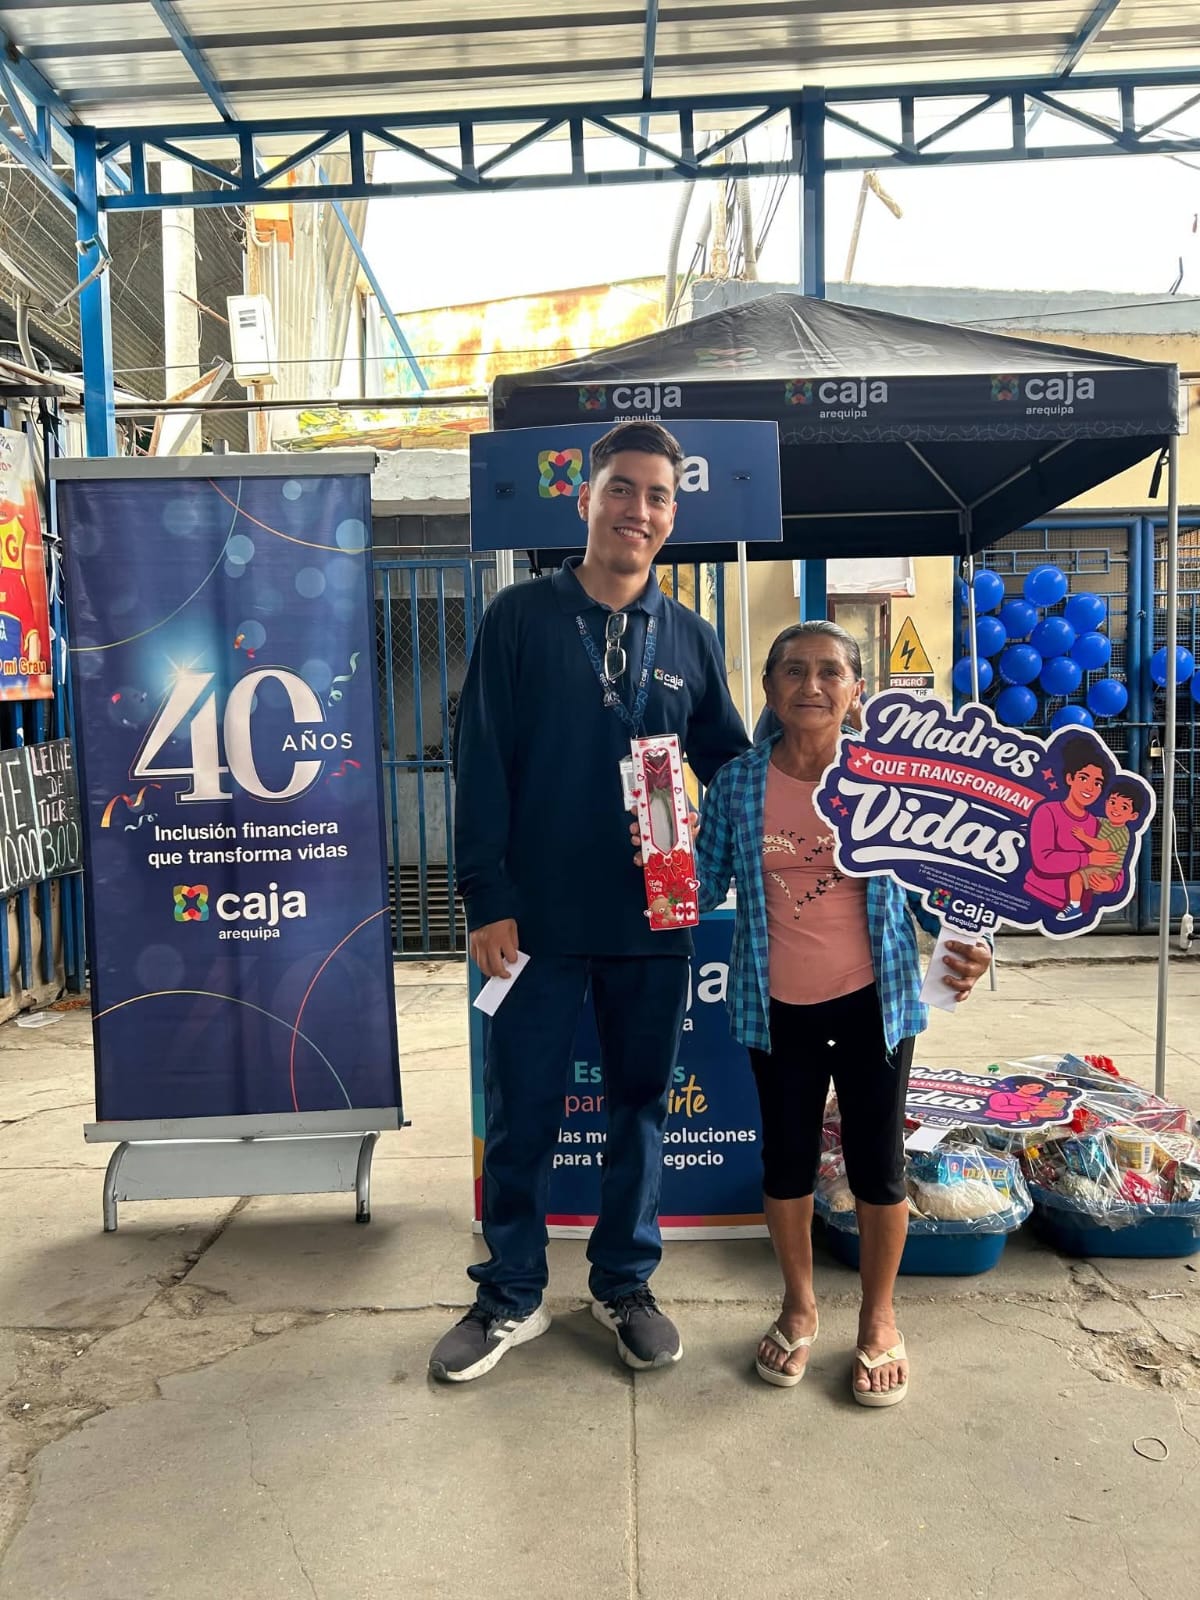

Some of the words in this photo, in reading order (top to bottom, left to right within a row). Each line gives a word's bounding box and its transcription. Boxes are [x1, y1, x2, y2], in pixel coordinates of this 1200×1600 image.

[612, 382, 682, 413] caja
[819, 377, 888, 408] caja
[1025, 371, 1095, 404] caja
[819, 408, 868, 419] arequipa
[1026, 405, 1075, 416] arequipa
[19, 657, 47, 675] Grau
[663, 673, 684, 688] caja
[133, 667, 326, 803] 40
[282, 730, 353, 752] AÑOS
[877, 703, 1040, 778] Madres
[47, 775, 65, 797] DE
[872, 759, 906, 777] QUE
[910, 763, 1035, 811] TRANSFORMAN
[154, 823, 237, 841] Inclusión
[241, 821, 339, 840] financiera
[838, 777, 1026, 874] Vidas
[148, 851, 183, 869] que
[188, 846, 292, 864] transforma
[298, 843, 348, 860] vidas
[216, 882, 307, 926] caja
[951, 899, 996, 925] caja
[948, 914, 979, 929] arequipa
[218, 927, 281, 941] arequipa
[663, 1127, 757, 1144] soluciones
[553, 1152, 592, 1168] para
[663, 1150, 724, 1170] egocio
